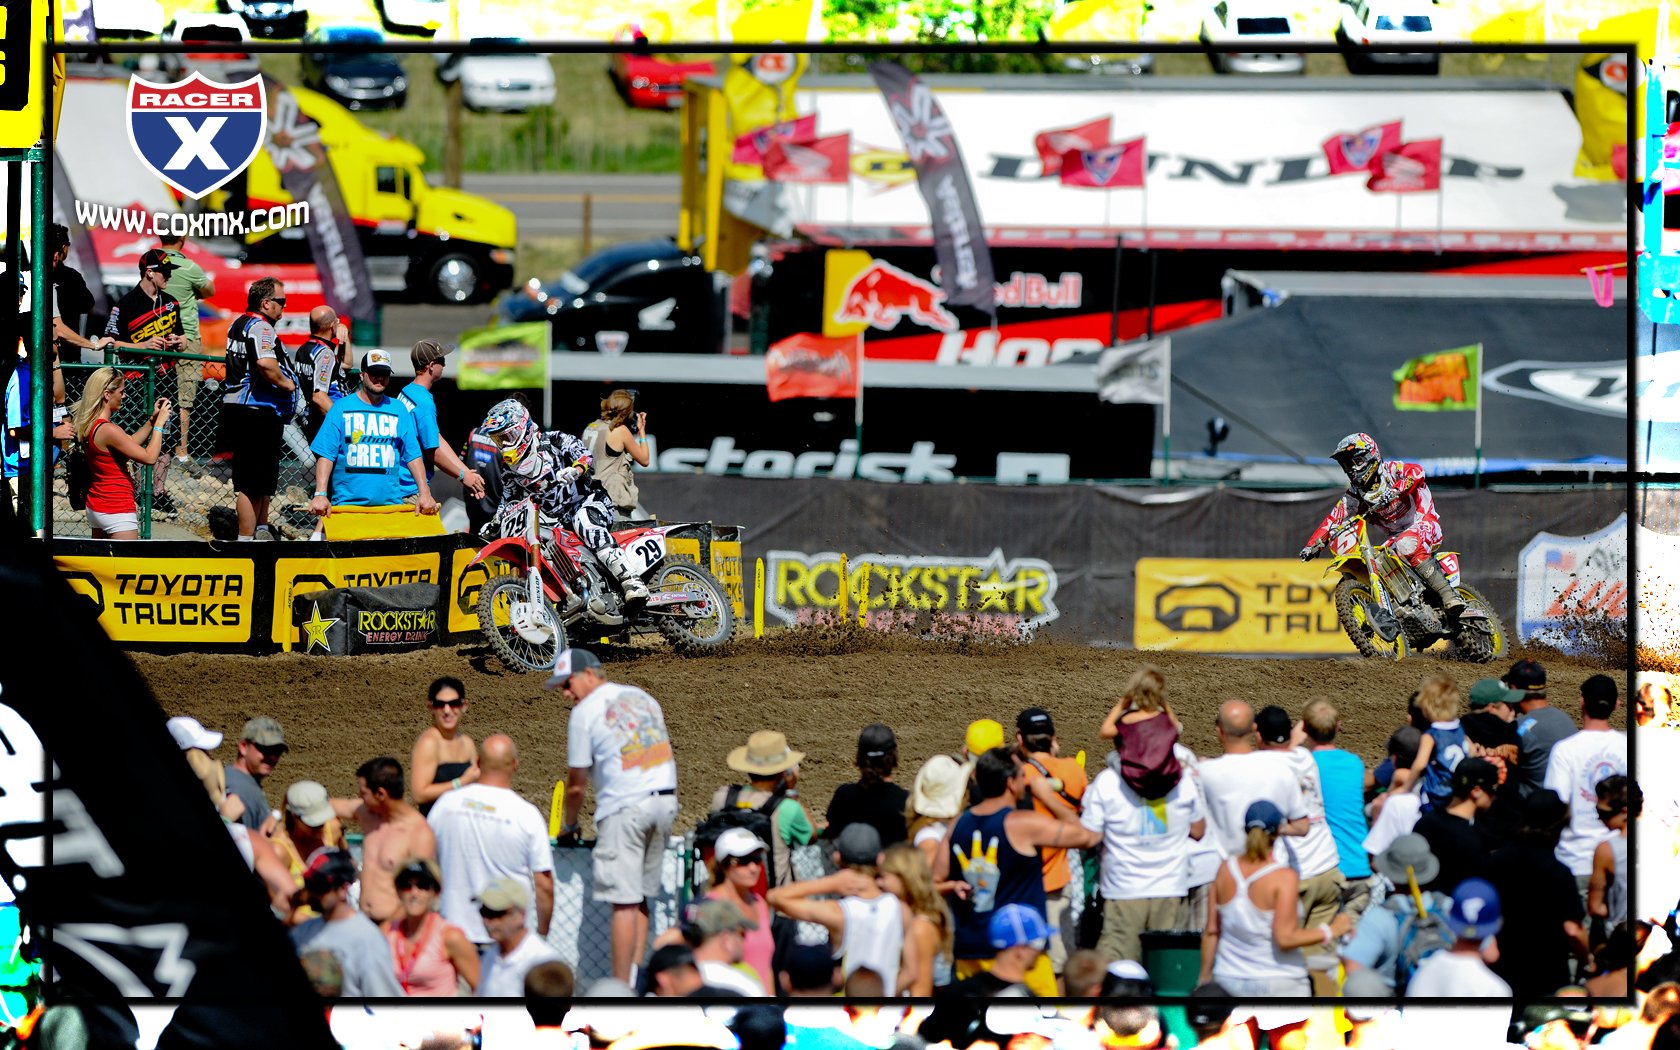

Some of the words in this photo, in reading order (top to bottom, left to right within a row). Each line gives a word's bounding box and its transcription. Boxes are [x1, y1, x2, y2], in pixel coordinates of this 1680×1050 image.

[342, 412, 399, 437] TRACK
[346, 444, 395, 468] CREW
[505, 509, 528, 537] 29
[1336, 526, 1358, 556] 5
[635, 539, 662, 568] 29
[1444, 557, 1458, 571] 5
[115, 574, 243, 597] TOYOTA
[536, 575, 544, 604] DUNLOP
[776, 559, 1050, 614] ROCKSTAR
[113, 602, 241, 626] TRUCKS
[359, 610, 437, 631] ROCKSTAR
[367, 631, 401, 643] ENERGY
